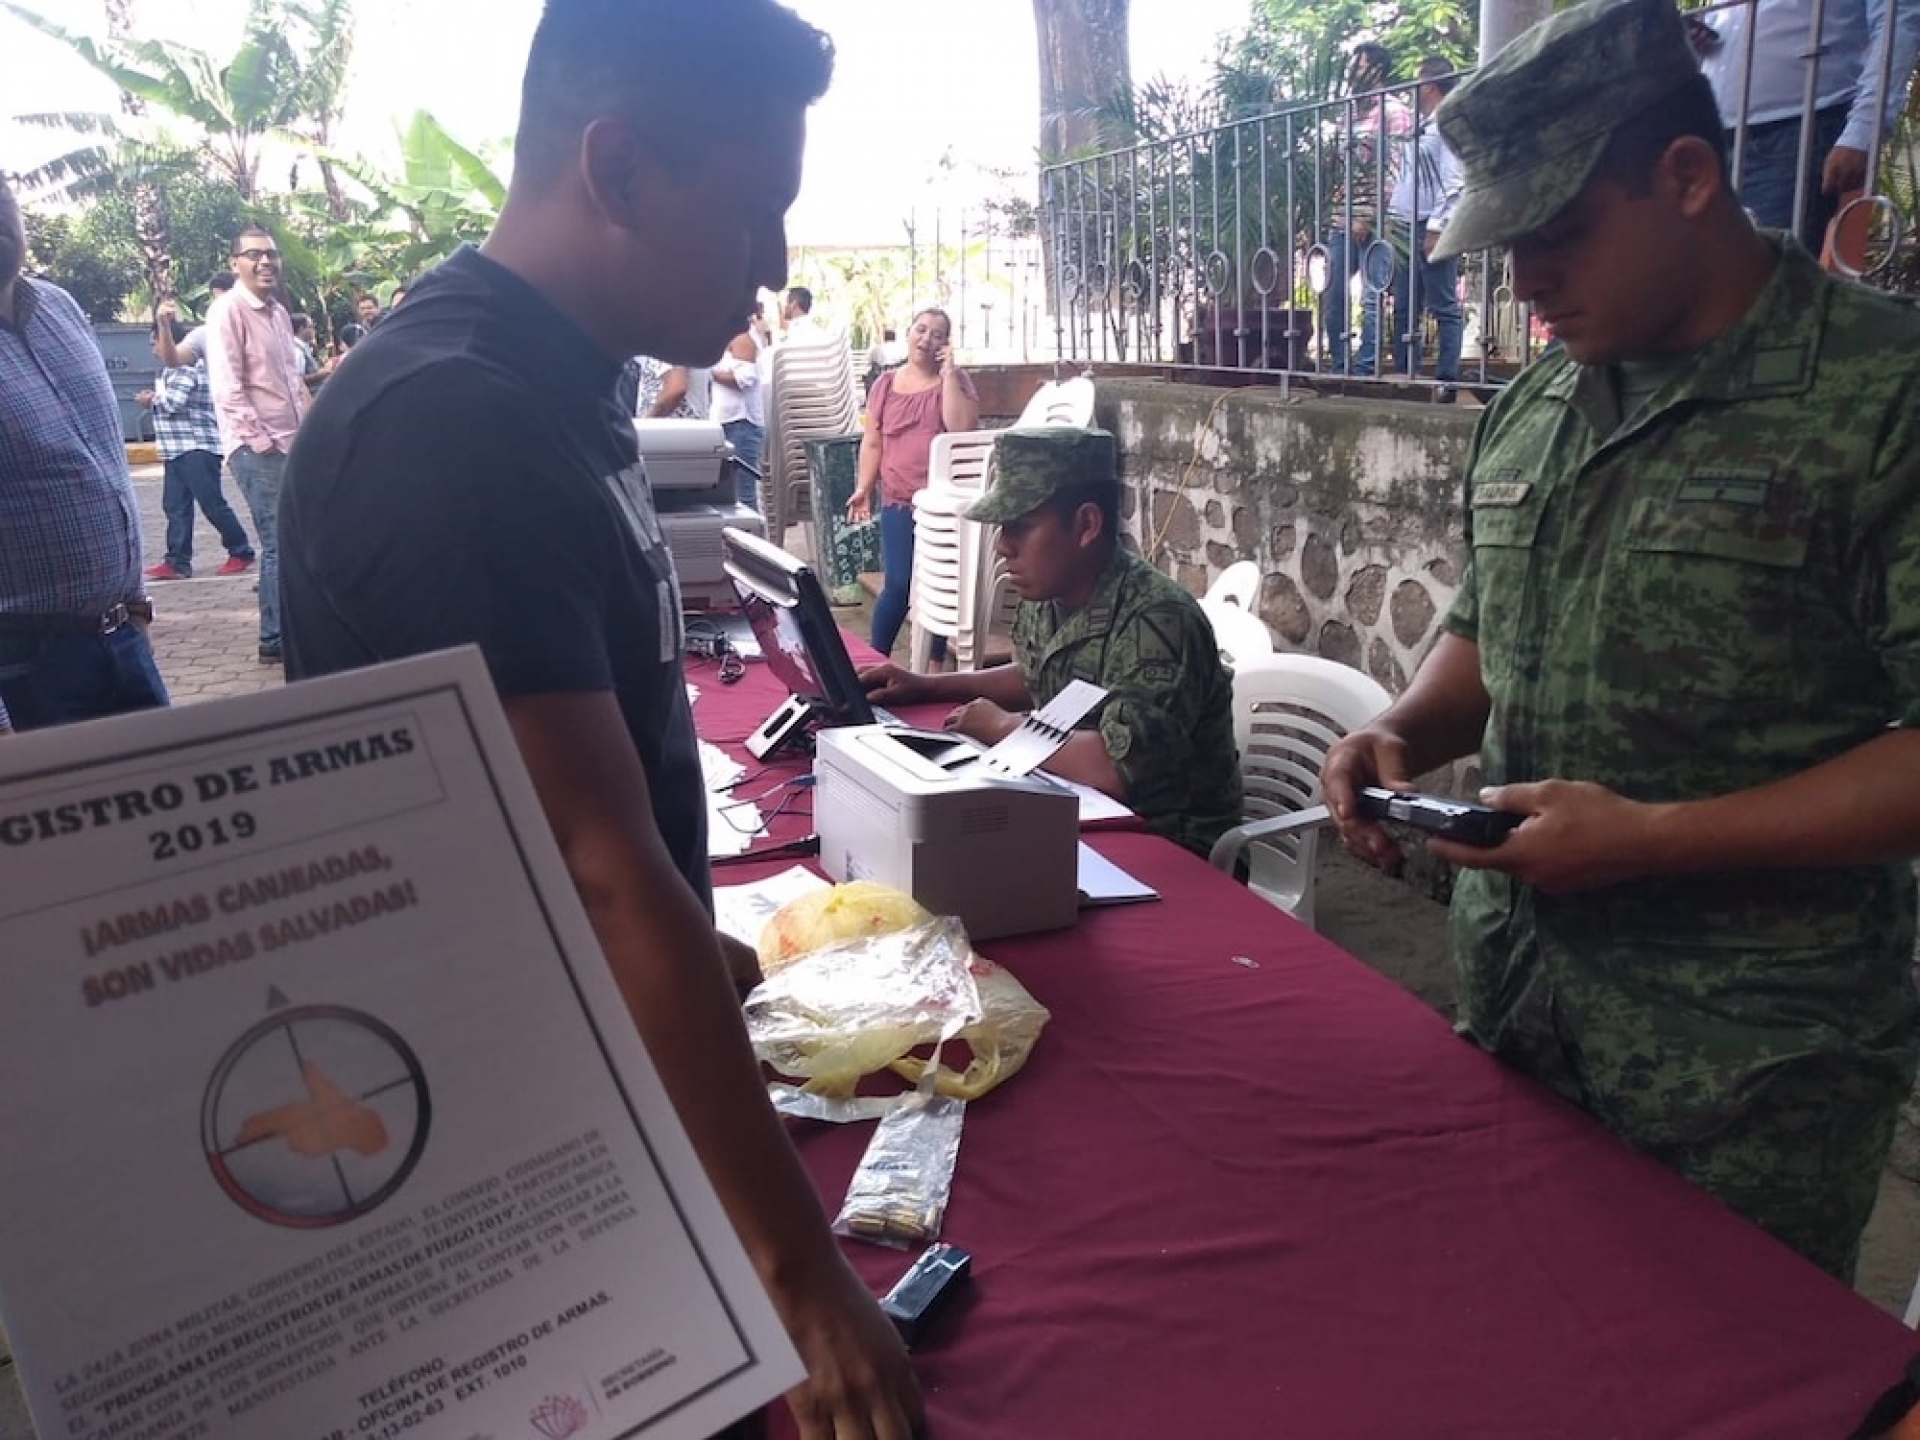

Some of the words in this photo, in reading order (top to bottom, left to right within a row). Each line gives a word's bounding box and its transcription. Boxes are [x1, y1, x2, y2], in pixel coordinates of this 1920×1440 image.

[192, 761, 260, 805] DE
[266, 725, 416, 788] ARMAS
[147, 807, 258, 861] 2019
[213, 841, 393, 917] CANJEADAS,
[80, 960, 155, 1007] SON
[156, 928, 256, 984] VIDAS
[256, 877, 421, 953] SALVADAS!
[205, 1341, 231, 1364] DE
[231, 1295, 324, 1351] REGISTROS
[321, 1285, 345, 1307] DE
[344, 1258, 403, 1296] ARMAS
[400, 1247, 425, 1269] DE
[423, 1223, 476, 1259] FUEGO
[354, 1387, 425, 1433] OFICINA
[423, 1374, 449, 1397] DE
[448, 1330, 531, 1383] REGISTRO
[529, 1318, 555, 1341] DE
[491, 1352, 529, 1381] 1010
